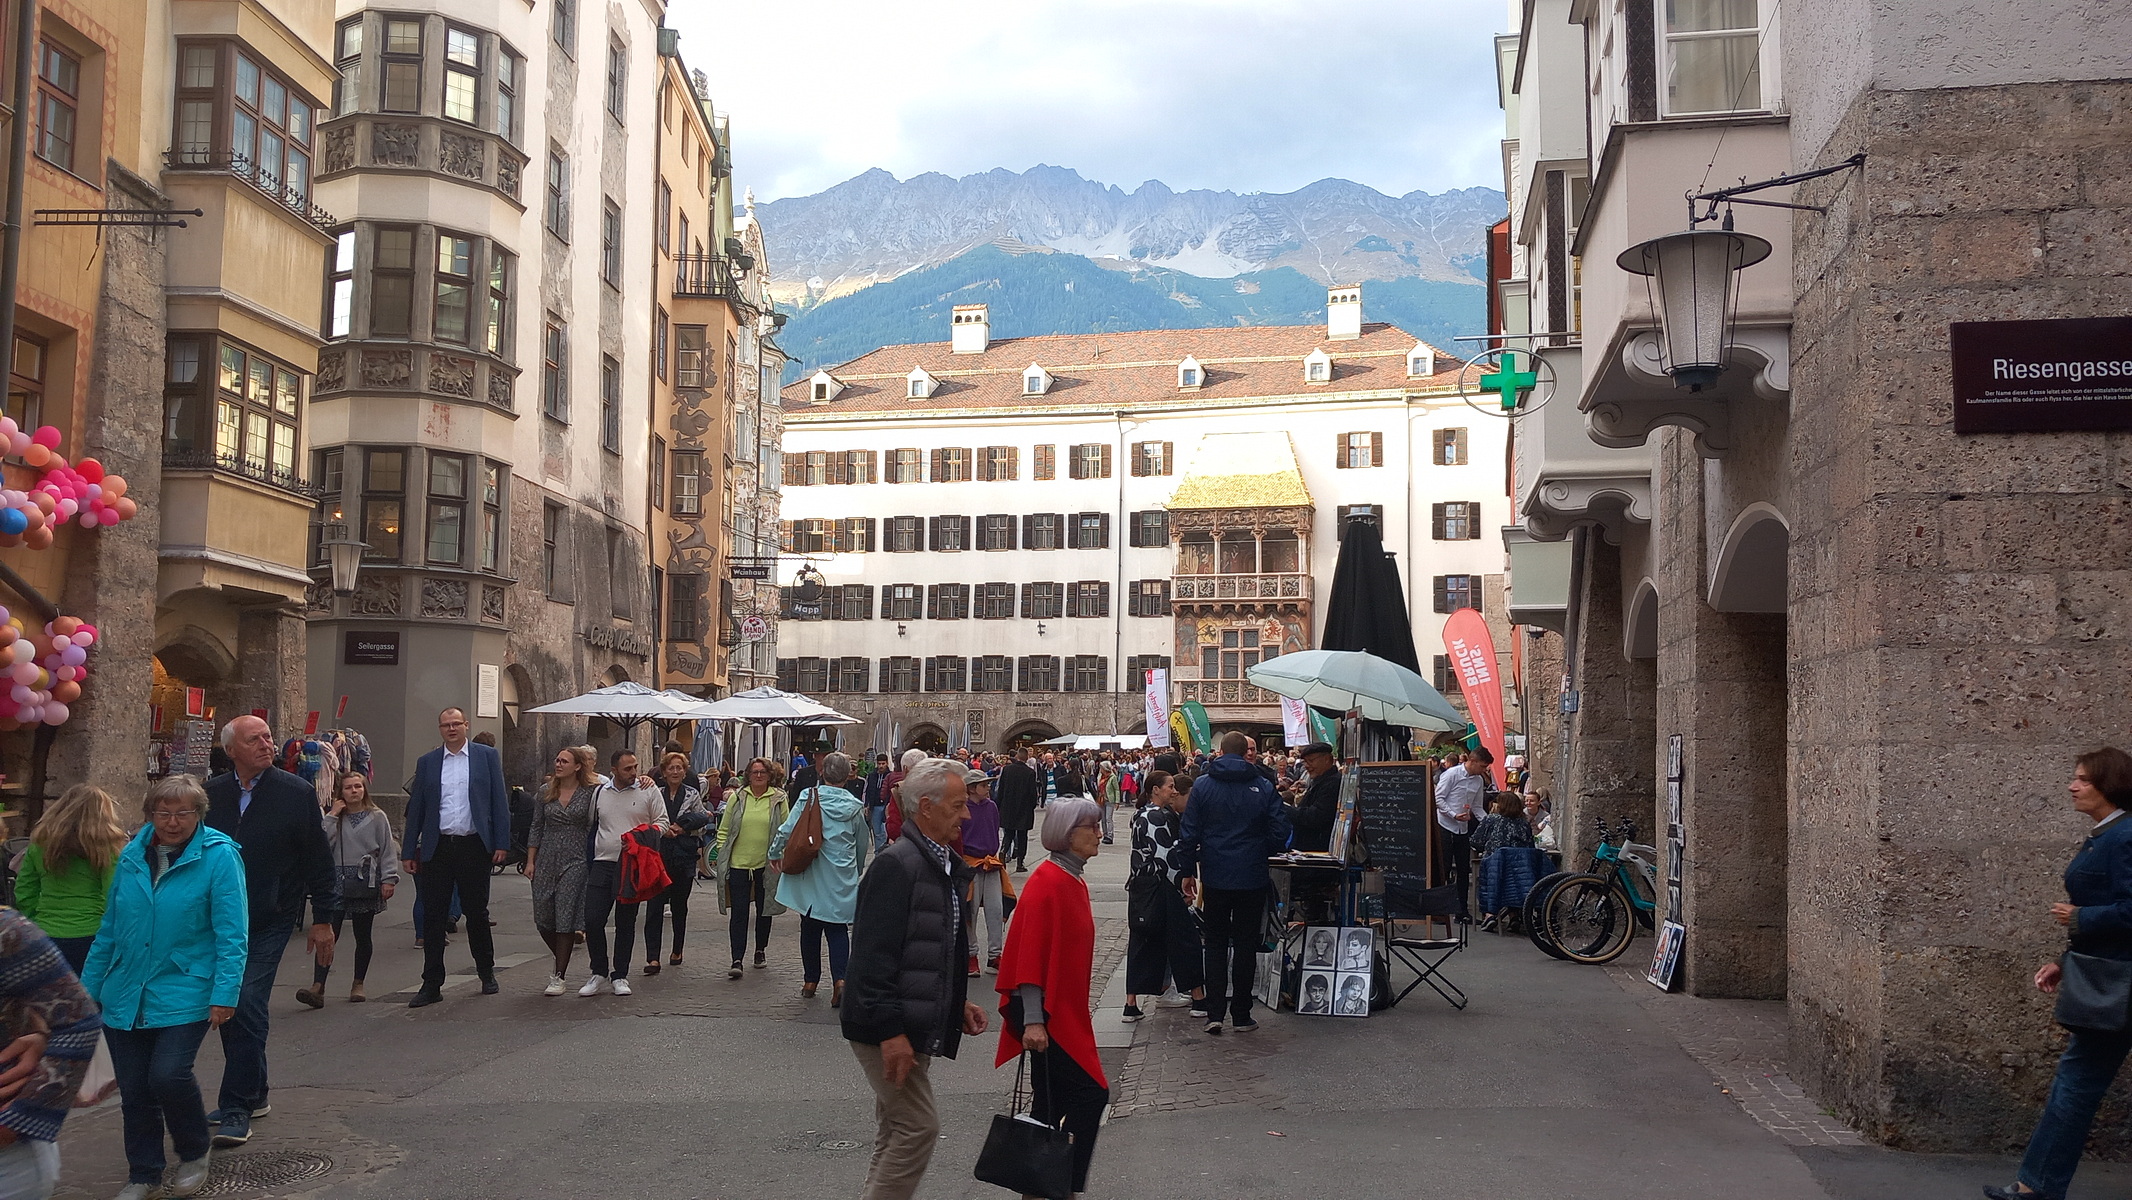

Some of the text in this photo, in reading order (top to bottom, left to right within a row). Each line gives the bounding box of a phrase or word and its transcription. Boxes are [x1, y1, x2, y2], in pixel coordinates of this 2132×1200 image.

[1993, 358, 2132, 382] Riesengasse
[733, 568, 766, 576] Weinhaus
[794, 604, 820, 614] Happ
[744, 625, 765, 634] HANDL
